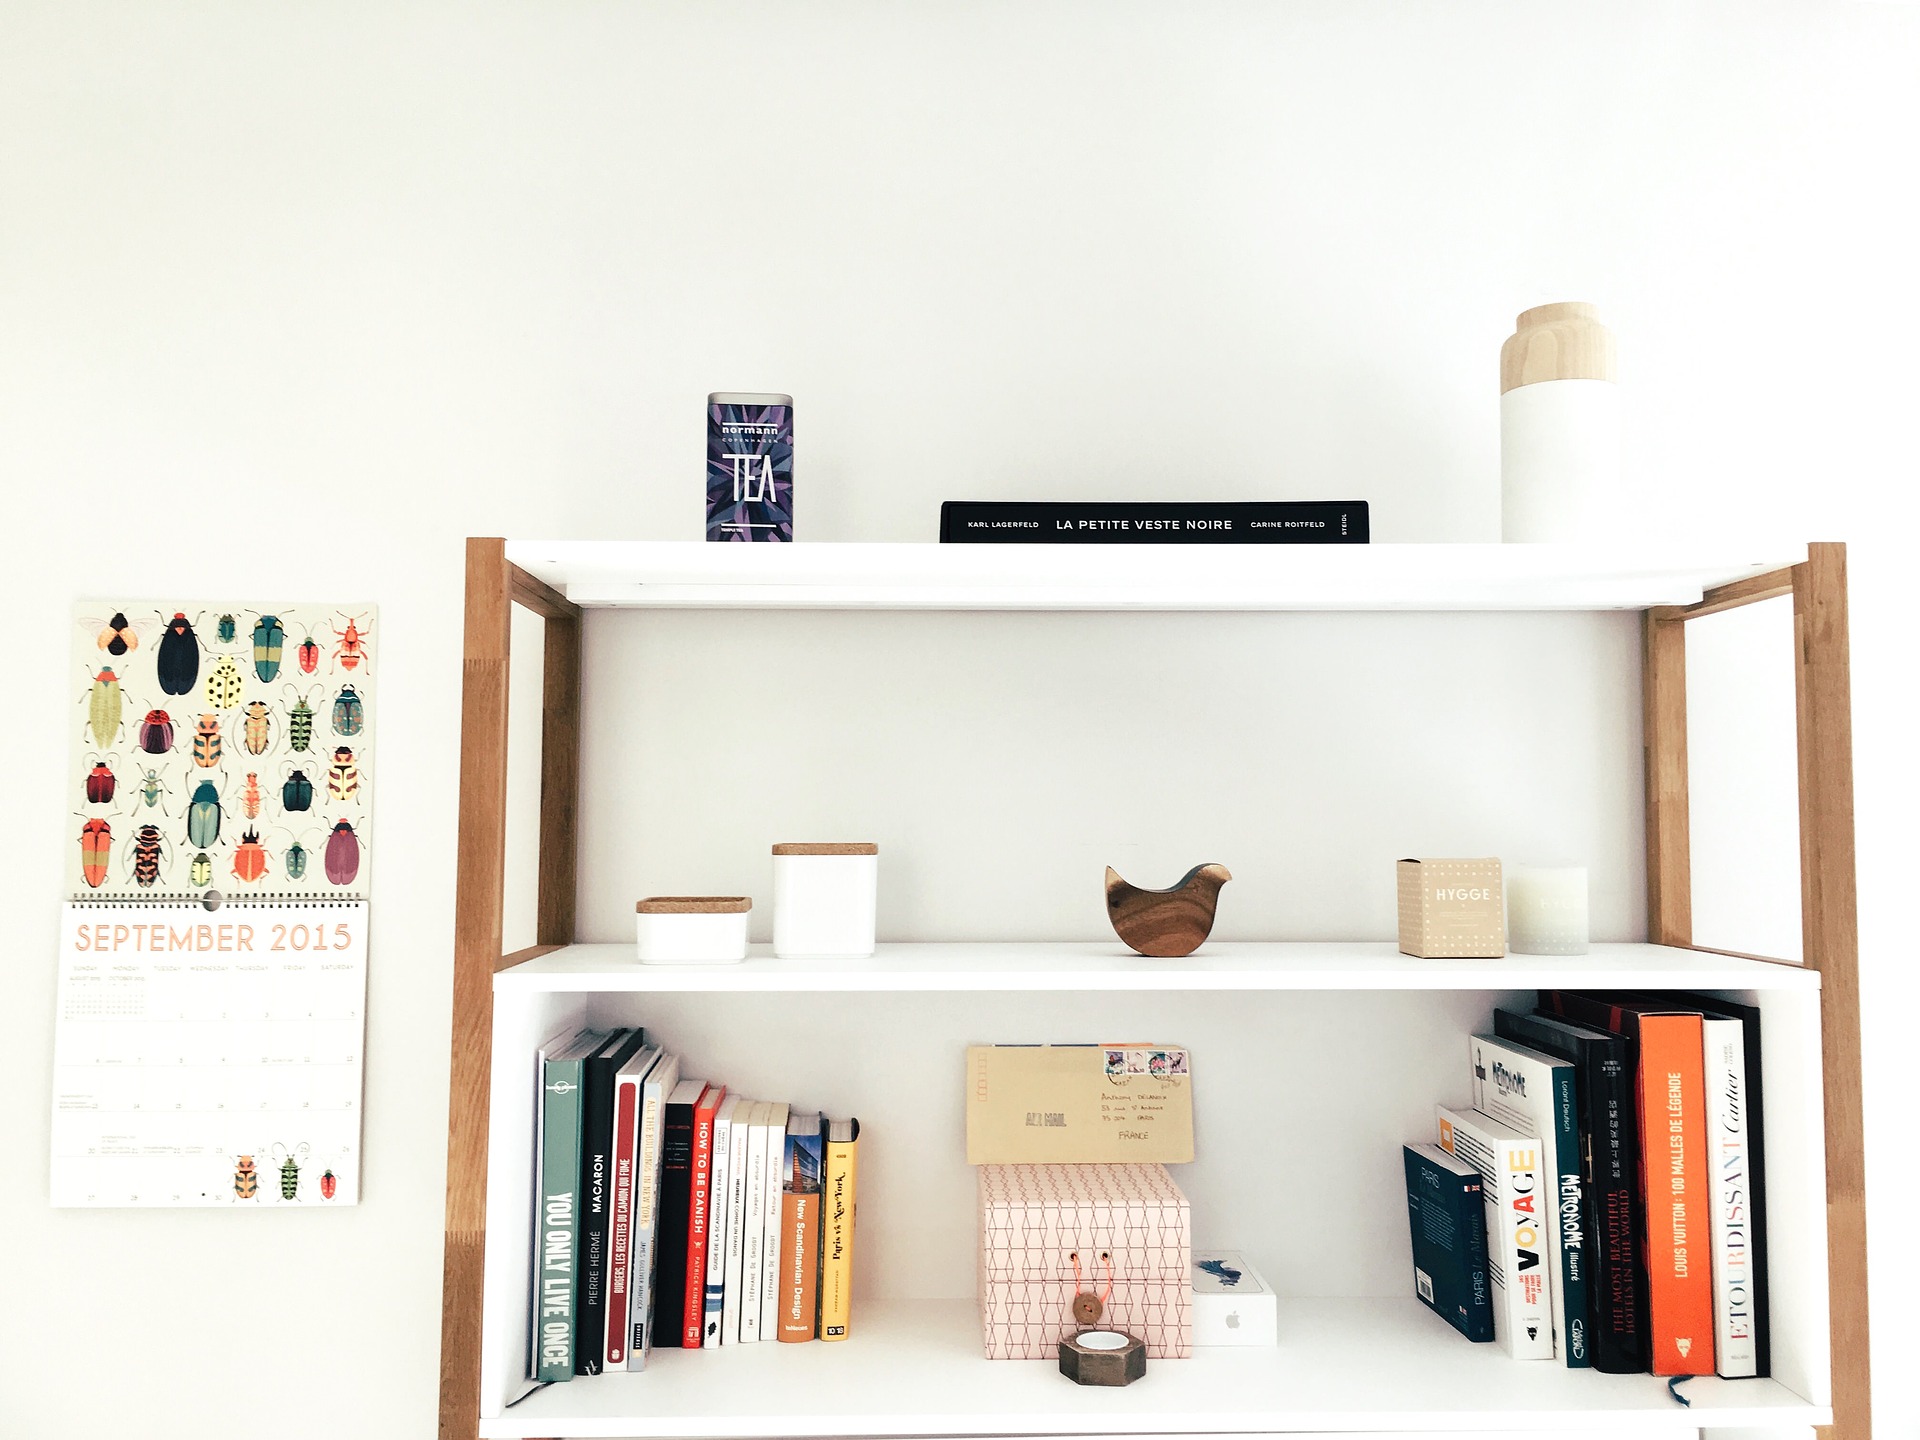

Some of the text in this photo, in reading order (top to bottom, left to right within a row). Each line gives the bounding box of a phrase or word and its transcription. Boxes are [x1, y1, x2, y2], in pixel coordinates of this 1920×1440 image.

[722, 427, 778, 435] normann
[722, 454, 777, 502] TEA
[1056, 520, 1232, 530] LA PETITE VESTE NOIRE
[1436, 888, 1490, 900] HYGGE
[75, 924, 352, 951] SEPTEMBER 2015
[647, 1100, 656, 1114] ALL
[1102, 1093, 1131, 1102] Anthony
[1666, 1072, 1683, 1117] LÉGENDE
[1722, 1069, 1740, 1133] Cartier
[646, 1117, 654, 1131] THE
[1044, 1112, 1067, 1127] MAIL
[1670, 1120, 1683, 1133] DE
[1118, 1131, 1149, 1140] FRANCE
[644, 1134, 654, 1171] BUILDINGS
[1670, 1135, 1684, 1175] MALLES
[592, 1155, 603, 1212] MACARON
[694, 1122, 708, 1234] HOW TO BE DANISH
[1421, 1167, 1440, 1188] PARIS
[1672, 1178, 1685, 1195] 100
[642, 1187, 651, 1203] NEW
[614, 1159, 630, 1294] BURGERS, LES RECETTES DU CAMION QUI FUME
[641, 1206, 650, 1225] YORK
[734, 1226, 738, 1235] UN
[833, 1172, 846, 1260] Paris vs New York
[714, 1243, 719, 1251] DE
[1723, 1137, 1748, 1339] ETOURDISSANT
[588, 1231, 600, 1305] PIERRE HERMÉ
[792, 1200, 806, 1320] New Scandinavian Design
[1569, 1252, 1579, 1282] illustré
[1608, 1191, 1624, 1333] THE MOST BEAUTIFUL
[1620, 1190, 1635, 1333] HOTELS IN THE WORLD
[1674, 1248, 1688, 1278] LOUIS
[543, 1192, 572, 1368] YOU ONLY LIVE ONCE
[1473, 1271, 1485, 1305] PARIS
